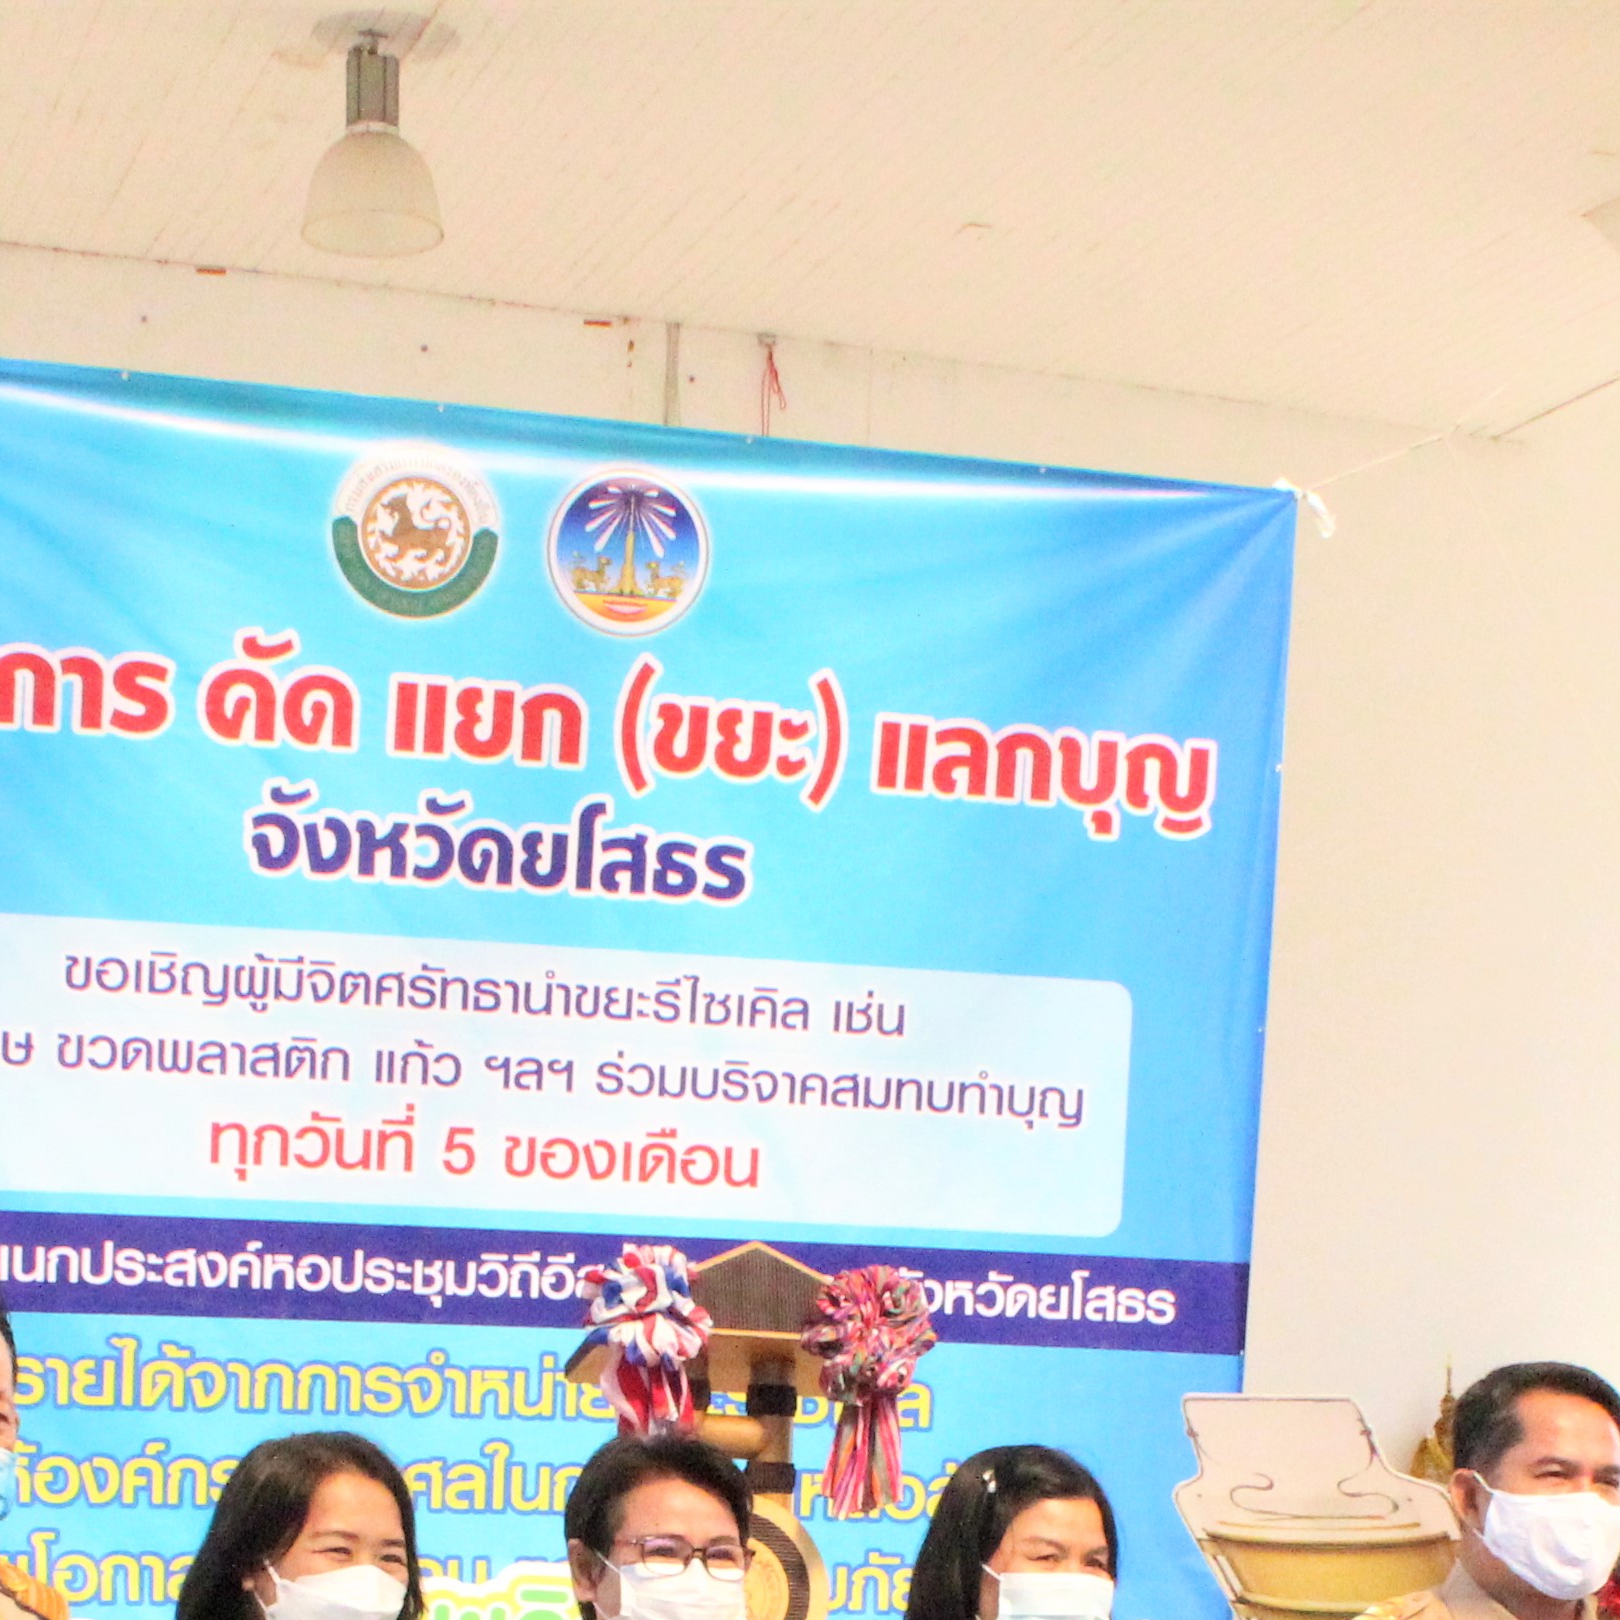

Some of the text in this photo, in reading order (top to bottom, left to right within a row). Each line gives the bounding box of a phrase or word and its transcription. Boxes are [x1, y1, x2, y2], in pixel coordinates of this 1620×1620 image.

[205, 633, 355, 748] คัด
[393, 677, 585, 768] แยก
[619, 661, 846, 807] (ขยะ)
[873, 720, 1211, 838] แลกบุญ
[252, 783, 749, 902] จังหวัดยโสธร
[64, 950, 906, 1038] ขอเชิญผู้มีจิตศรัทธานำขยะรีไซเคิล เช่น
[57, 1033, 350, 1084] ขวดพลาสติก
[375, 1041, 462, 1088] แก้ว
[484, 1052, 576, 1095] ฯลฯ
[594, 1050, 1085, 1131] ร่วมบริจาคสมทบทำบุญ
[209, 1105, 761, 1189] ทุกวันที่ 5 ของเดือน
[899, 1267, 1178, 1327] ังหวัดยโสธร
